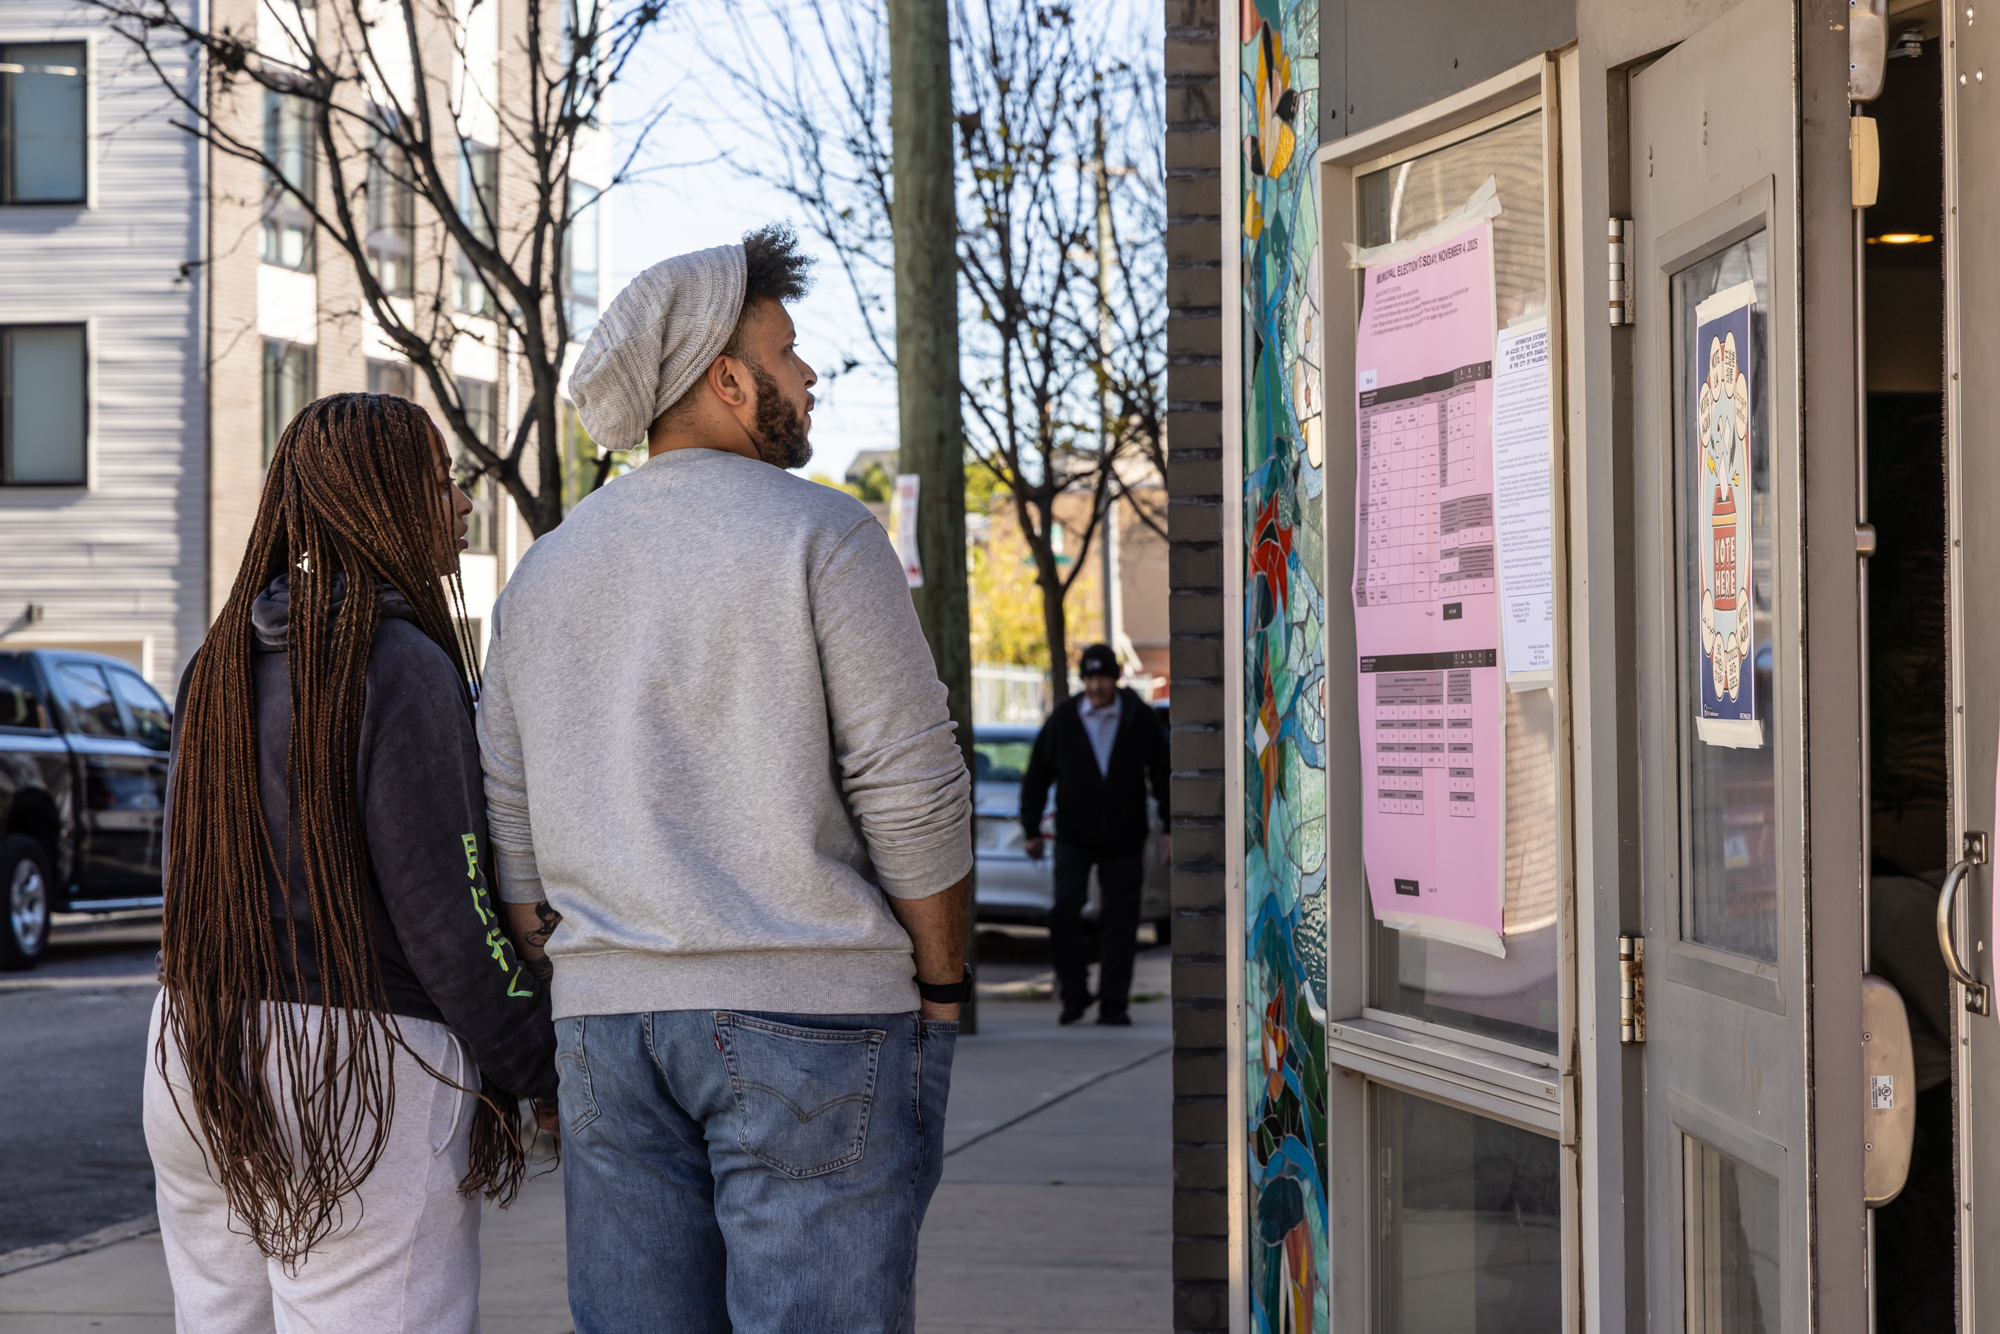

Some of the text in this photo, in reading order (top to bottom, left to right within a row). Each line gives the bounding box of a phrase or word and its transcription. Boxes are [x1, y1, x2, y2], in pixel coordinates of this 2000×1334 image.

[1397, 260, 1418, 277] ELECTION
[1438, 243, 1462, 262] NOVEMBER
[1467, 238, 1478, 252] 2025
[1531, 340, 1544, 349] ELECTION
[1714, 535, 1736, 566] VOTE
[1715, 568, 1736, 599] HERE
